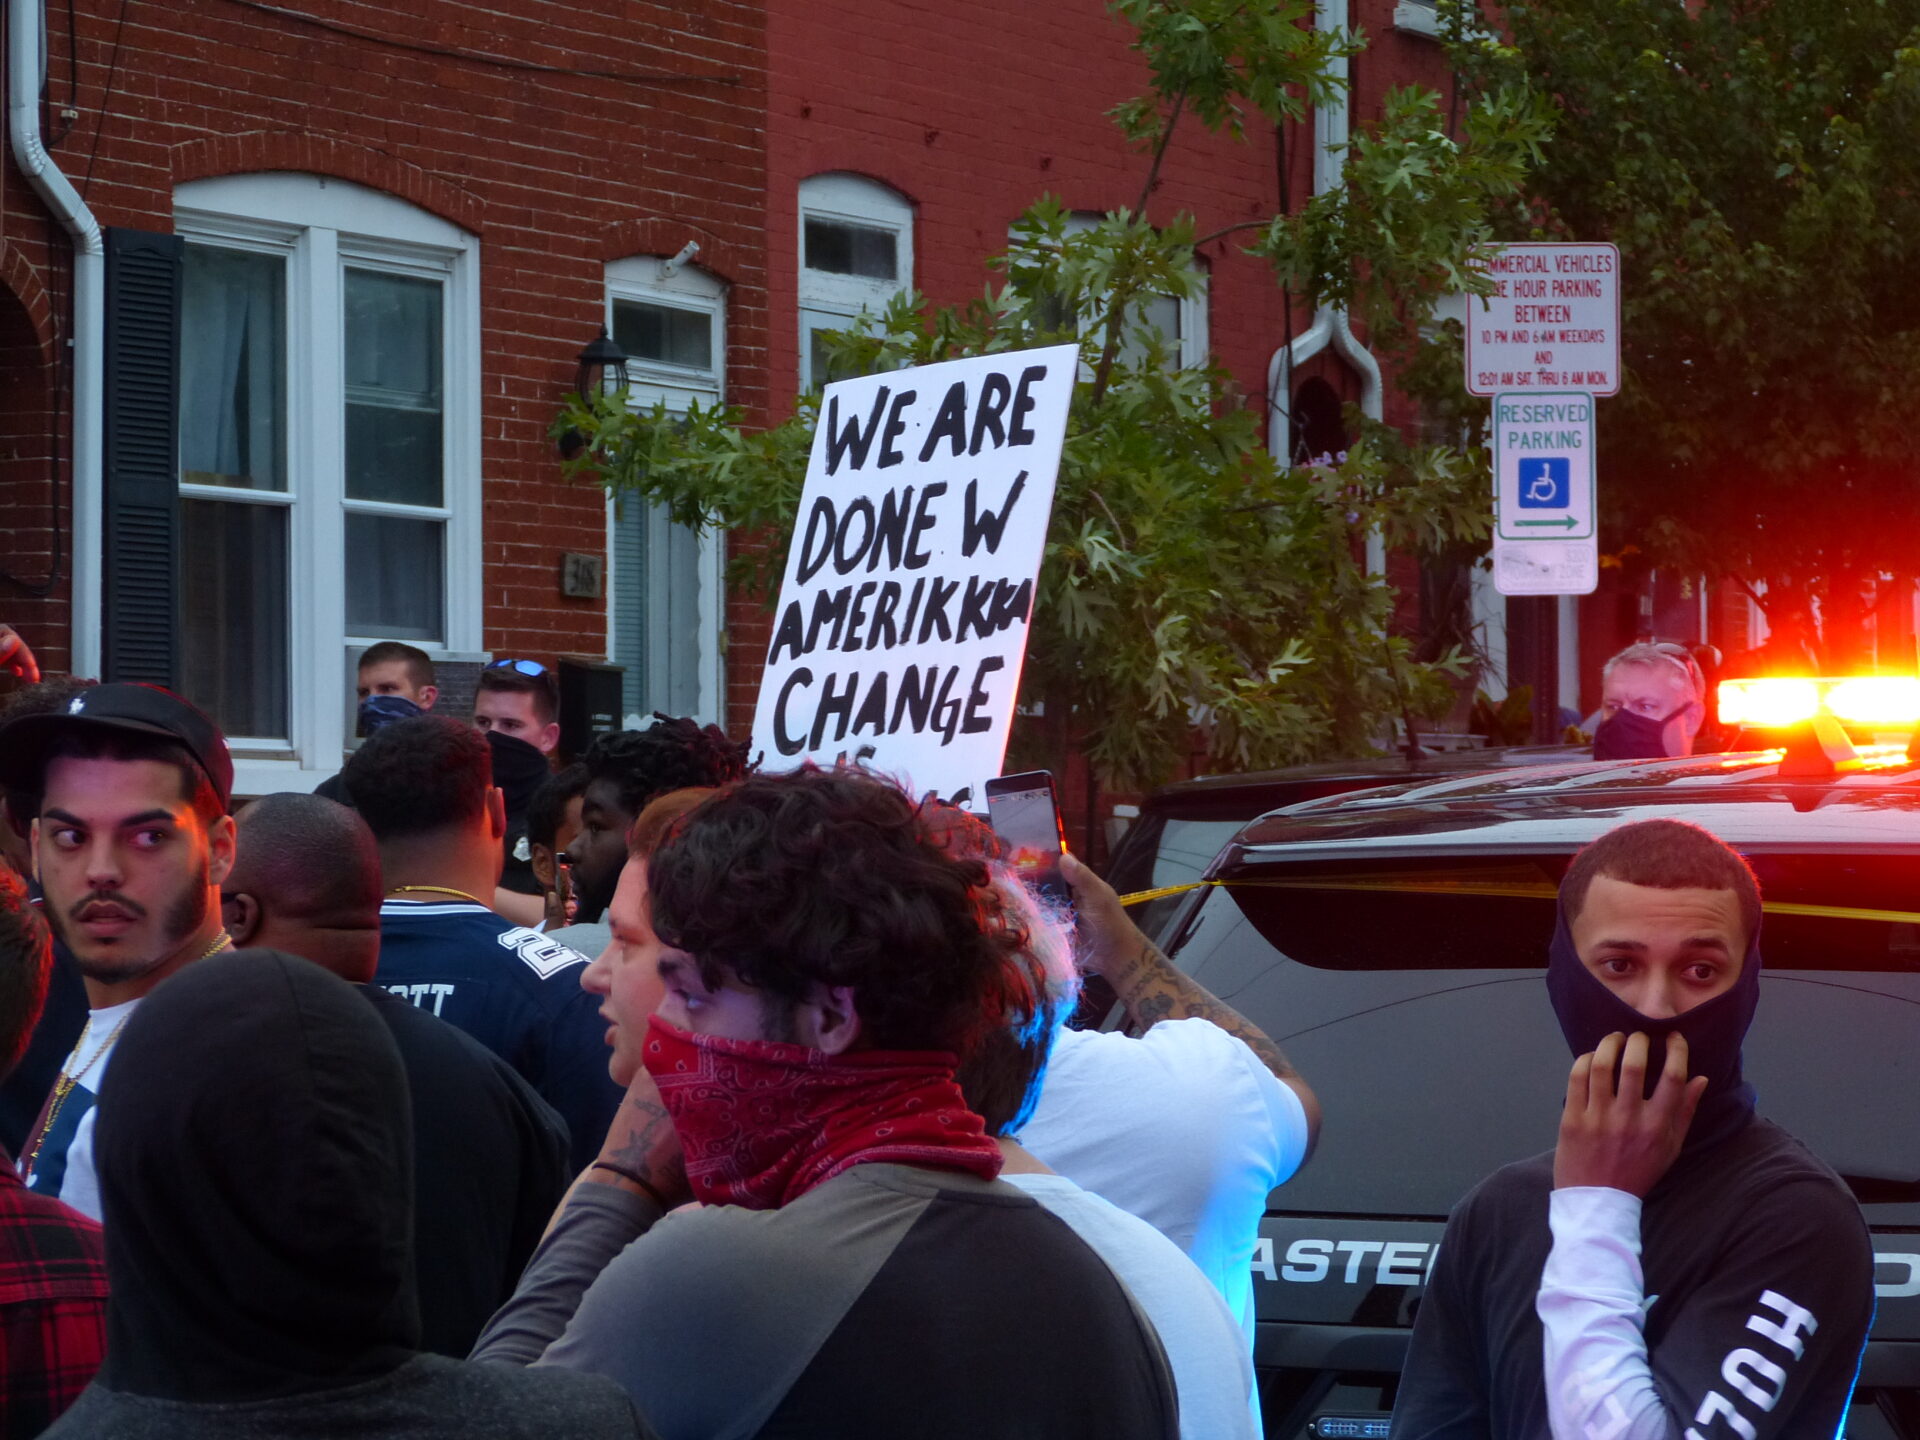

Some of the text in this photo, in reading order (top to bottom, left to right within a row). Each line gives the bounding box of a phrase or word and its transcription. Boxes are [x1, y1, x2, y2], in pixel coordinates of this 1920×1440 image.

[1474, 255, 1612, 273] MMERCIAL VEHICLES
[1514, 280, 1547, 298] HOUR
[1552, 280, 1602, 298] PARKING
[1515, 305, 1571, 323] BETWEEN
[1481, 329, 1606, 344] 10 PM AND 6 AM WEEKDAYS
[1534, 351, 1553, 364] AND
[1501, 372, 1514, 385] AM
[1537, 372, 1560, 385] THRU
[1562, 372, 1568, 385] 6
[1572, 372, 1584, 385] AM
[825, 365, 1047, 476] WE ARE
[1500, 404, 1589, 423] RESERVED
[1508, 430, 1582, 449] PARKING
[796, 470, 1029, 586] DONE W
[768, 575, 1033, 665] AMERIKKKA
[773, 656, 1005, 757] CHANGE
[497, 926, 587, 980] 2
[1250, 1237, 1440, 1286] ASTE
[1684, 1289, 1819, 1440] HOL
